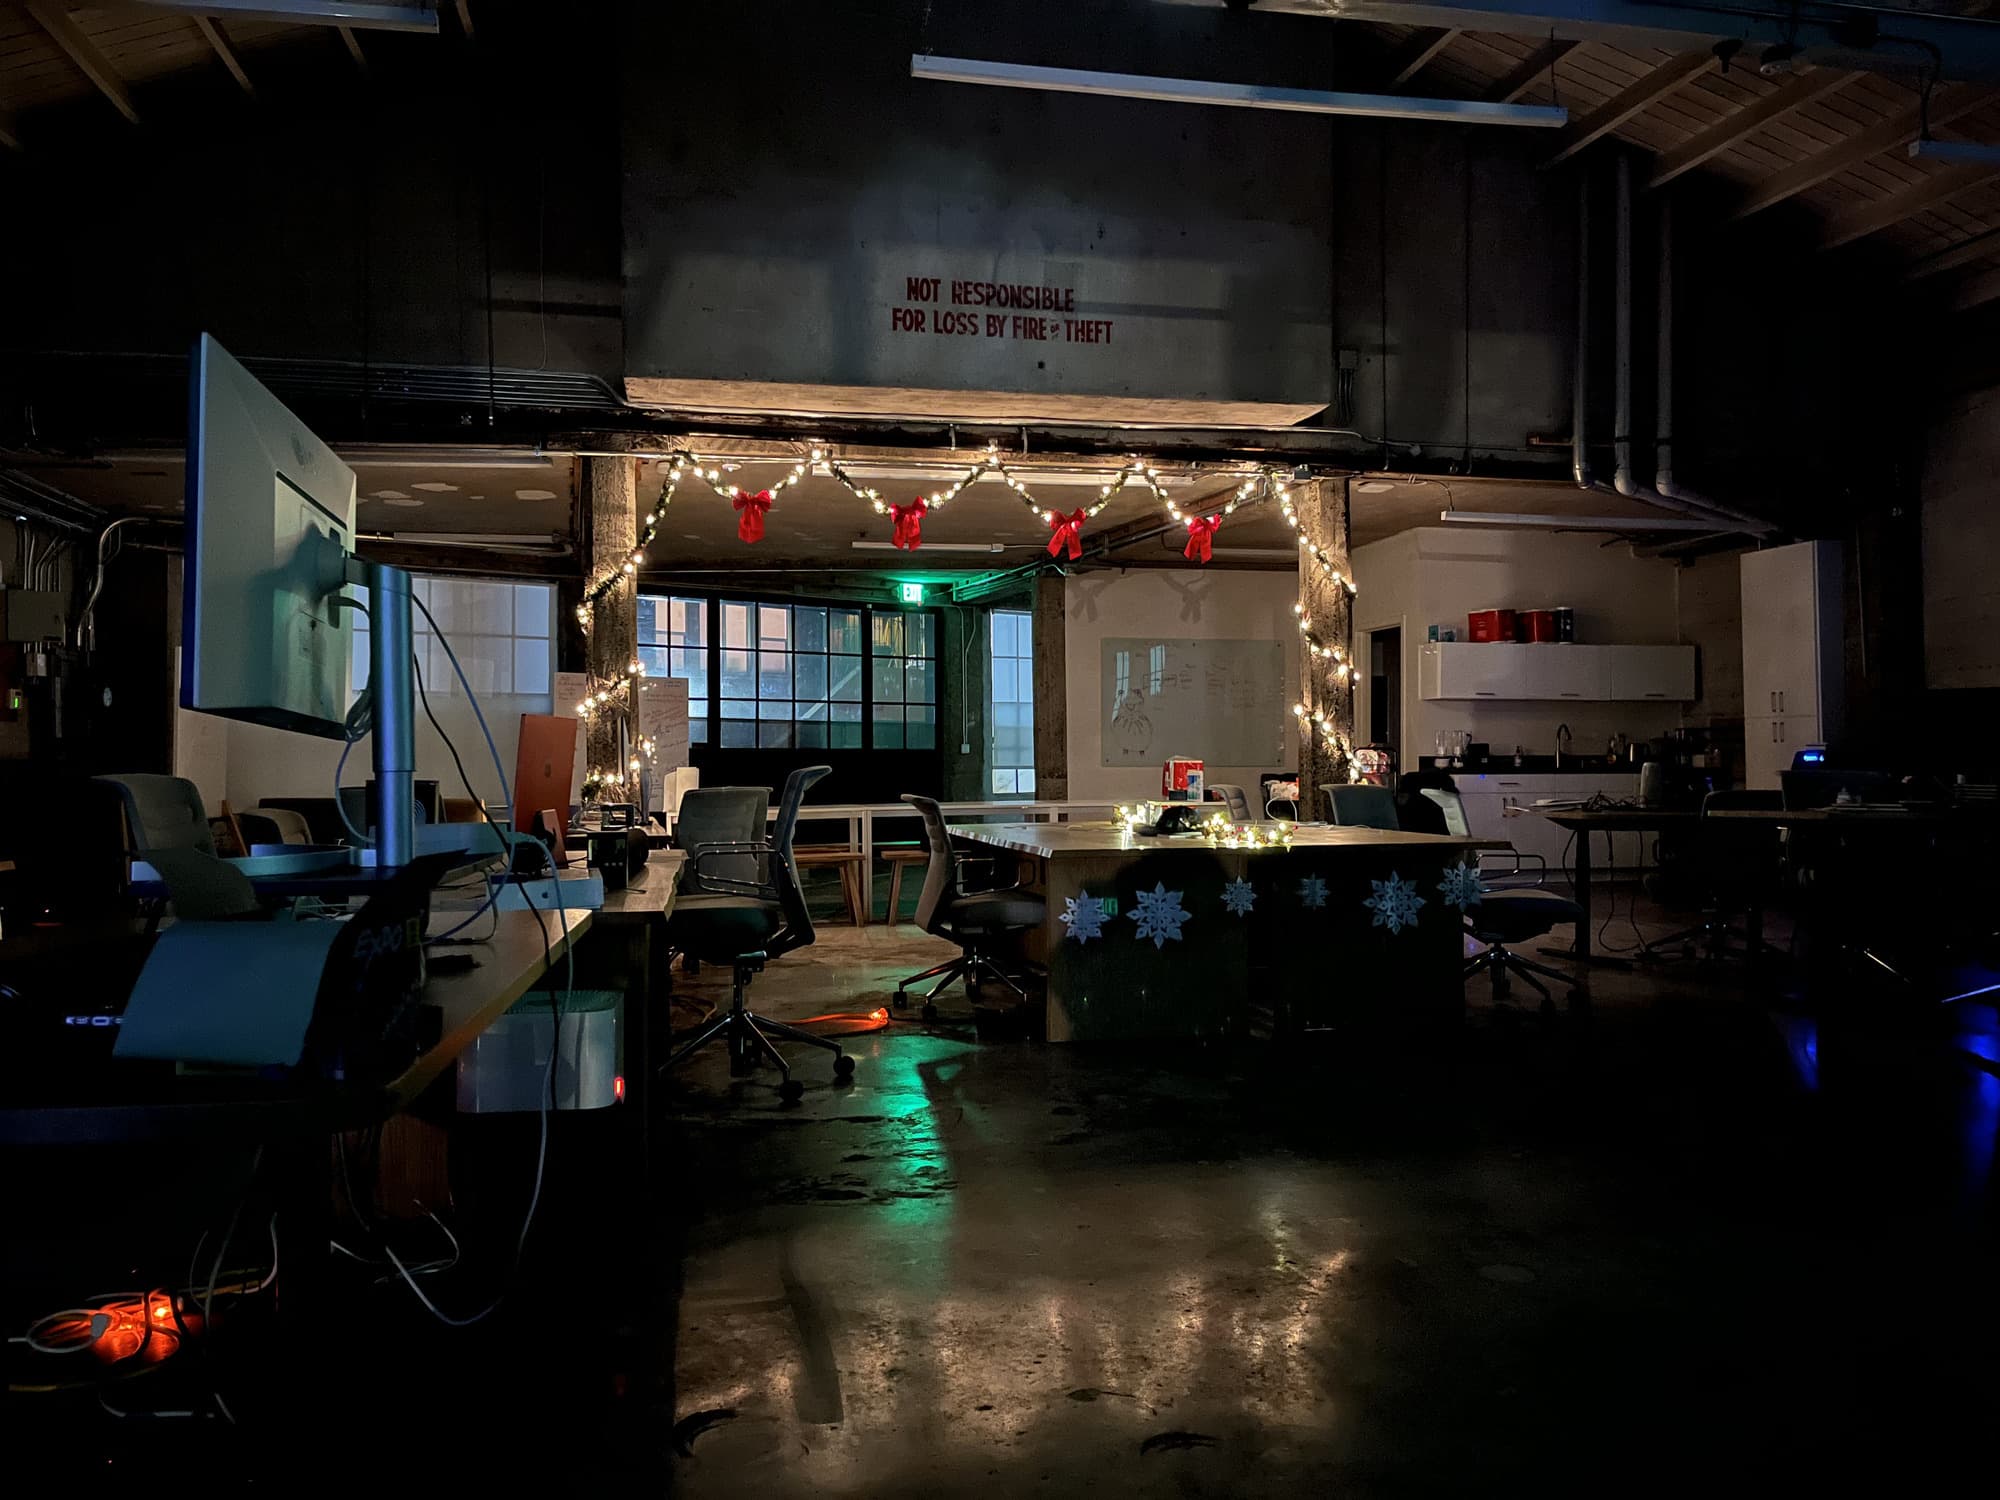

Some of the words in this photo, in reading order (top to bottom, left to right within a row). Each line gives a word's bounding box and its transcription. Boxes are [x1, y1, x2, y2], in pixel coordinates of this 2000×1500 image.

[906, 277, 941, 302] NOT
[951, 281, 1074, 312] RESPONSIBLE
[892, 308, 926, 333] FOR
[933, 311, 978, 336] LOSS
[986, 314, 1007, 338] BY
[1012, 316, 1047, 341] FIRE
[1064, 320, 1113, 344] THEFT
